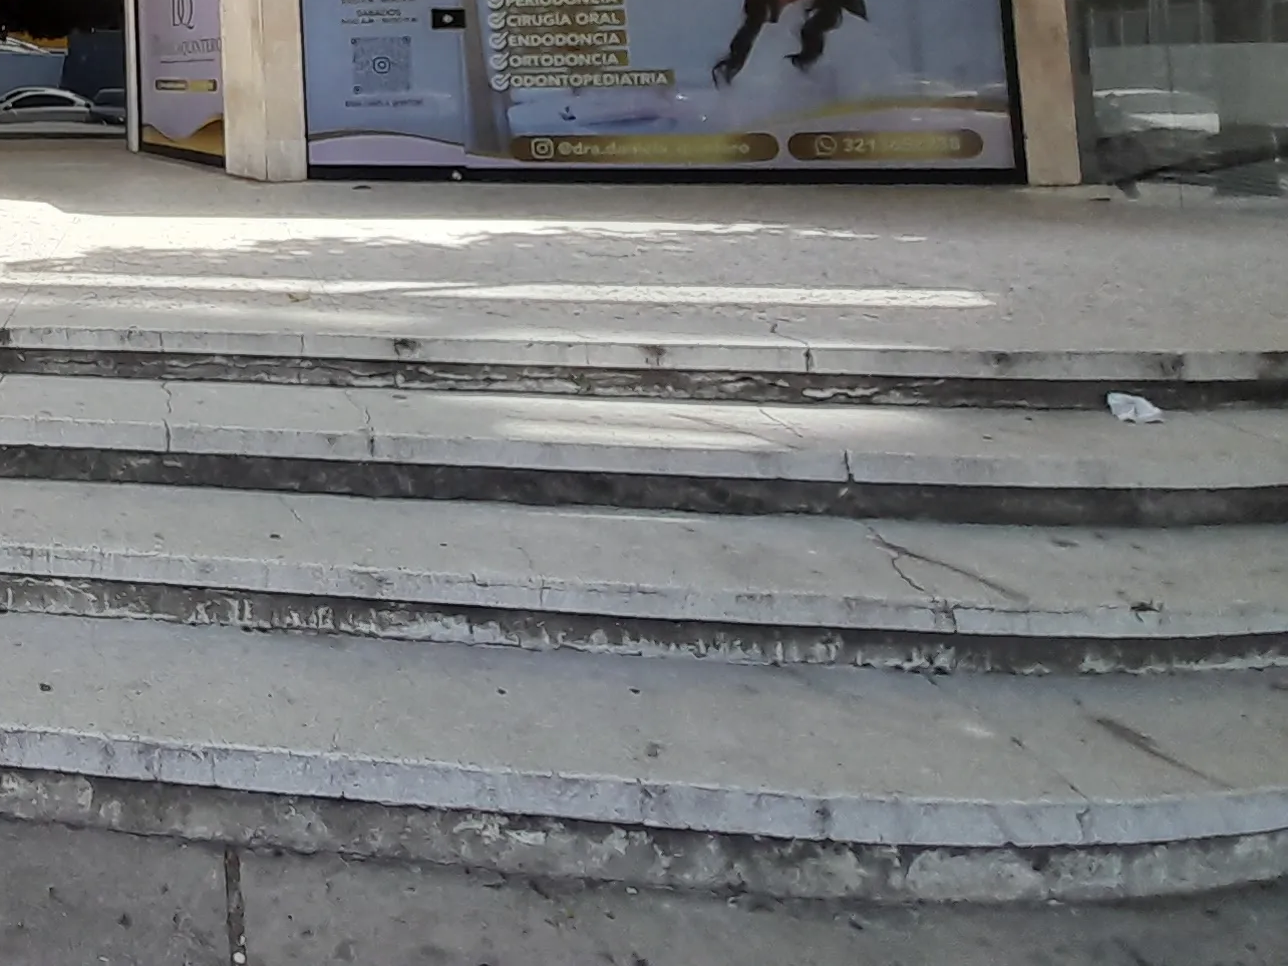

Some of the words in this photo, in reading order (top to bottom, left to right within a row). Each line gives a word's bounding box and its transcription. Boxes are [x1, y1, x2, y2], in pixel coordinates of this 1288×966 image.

[575, 12, 620, 25] ORAL
[508, 32, 620, 47] ENDODONCIA
[509, 53, 619, 67] ORTODONCIA
